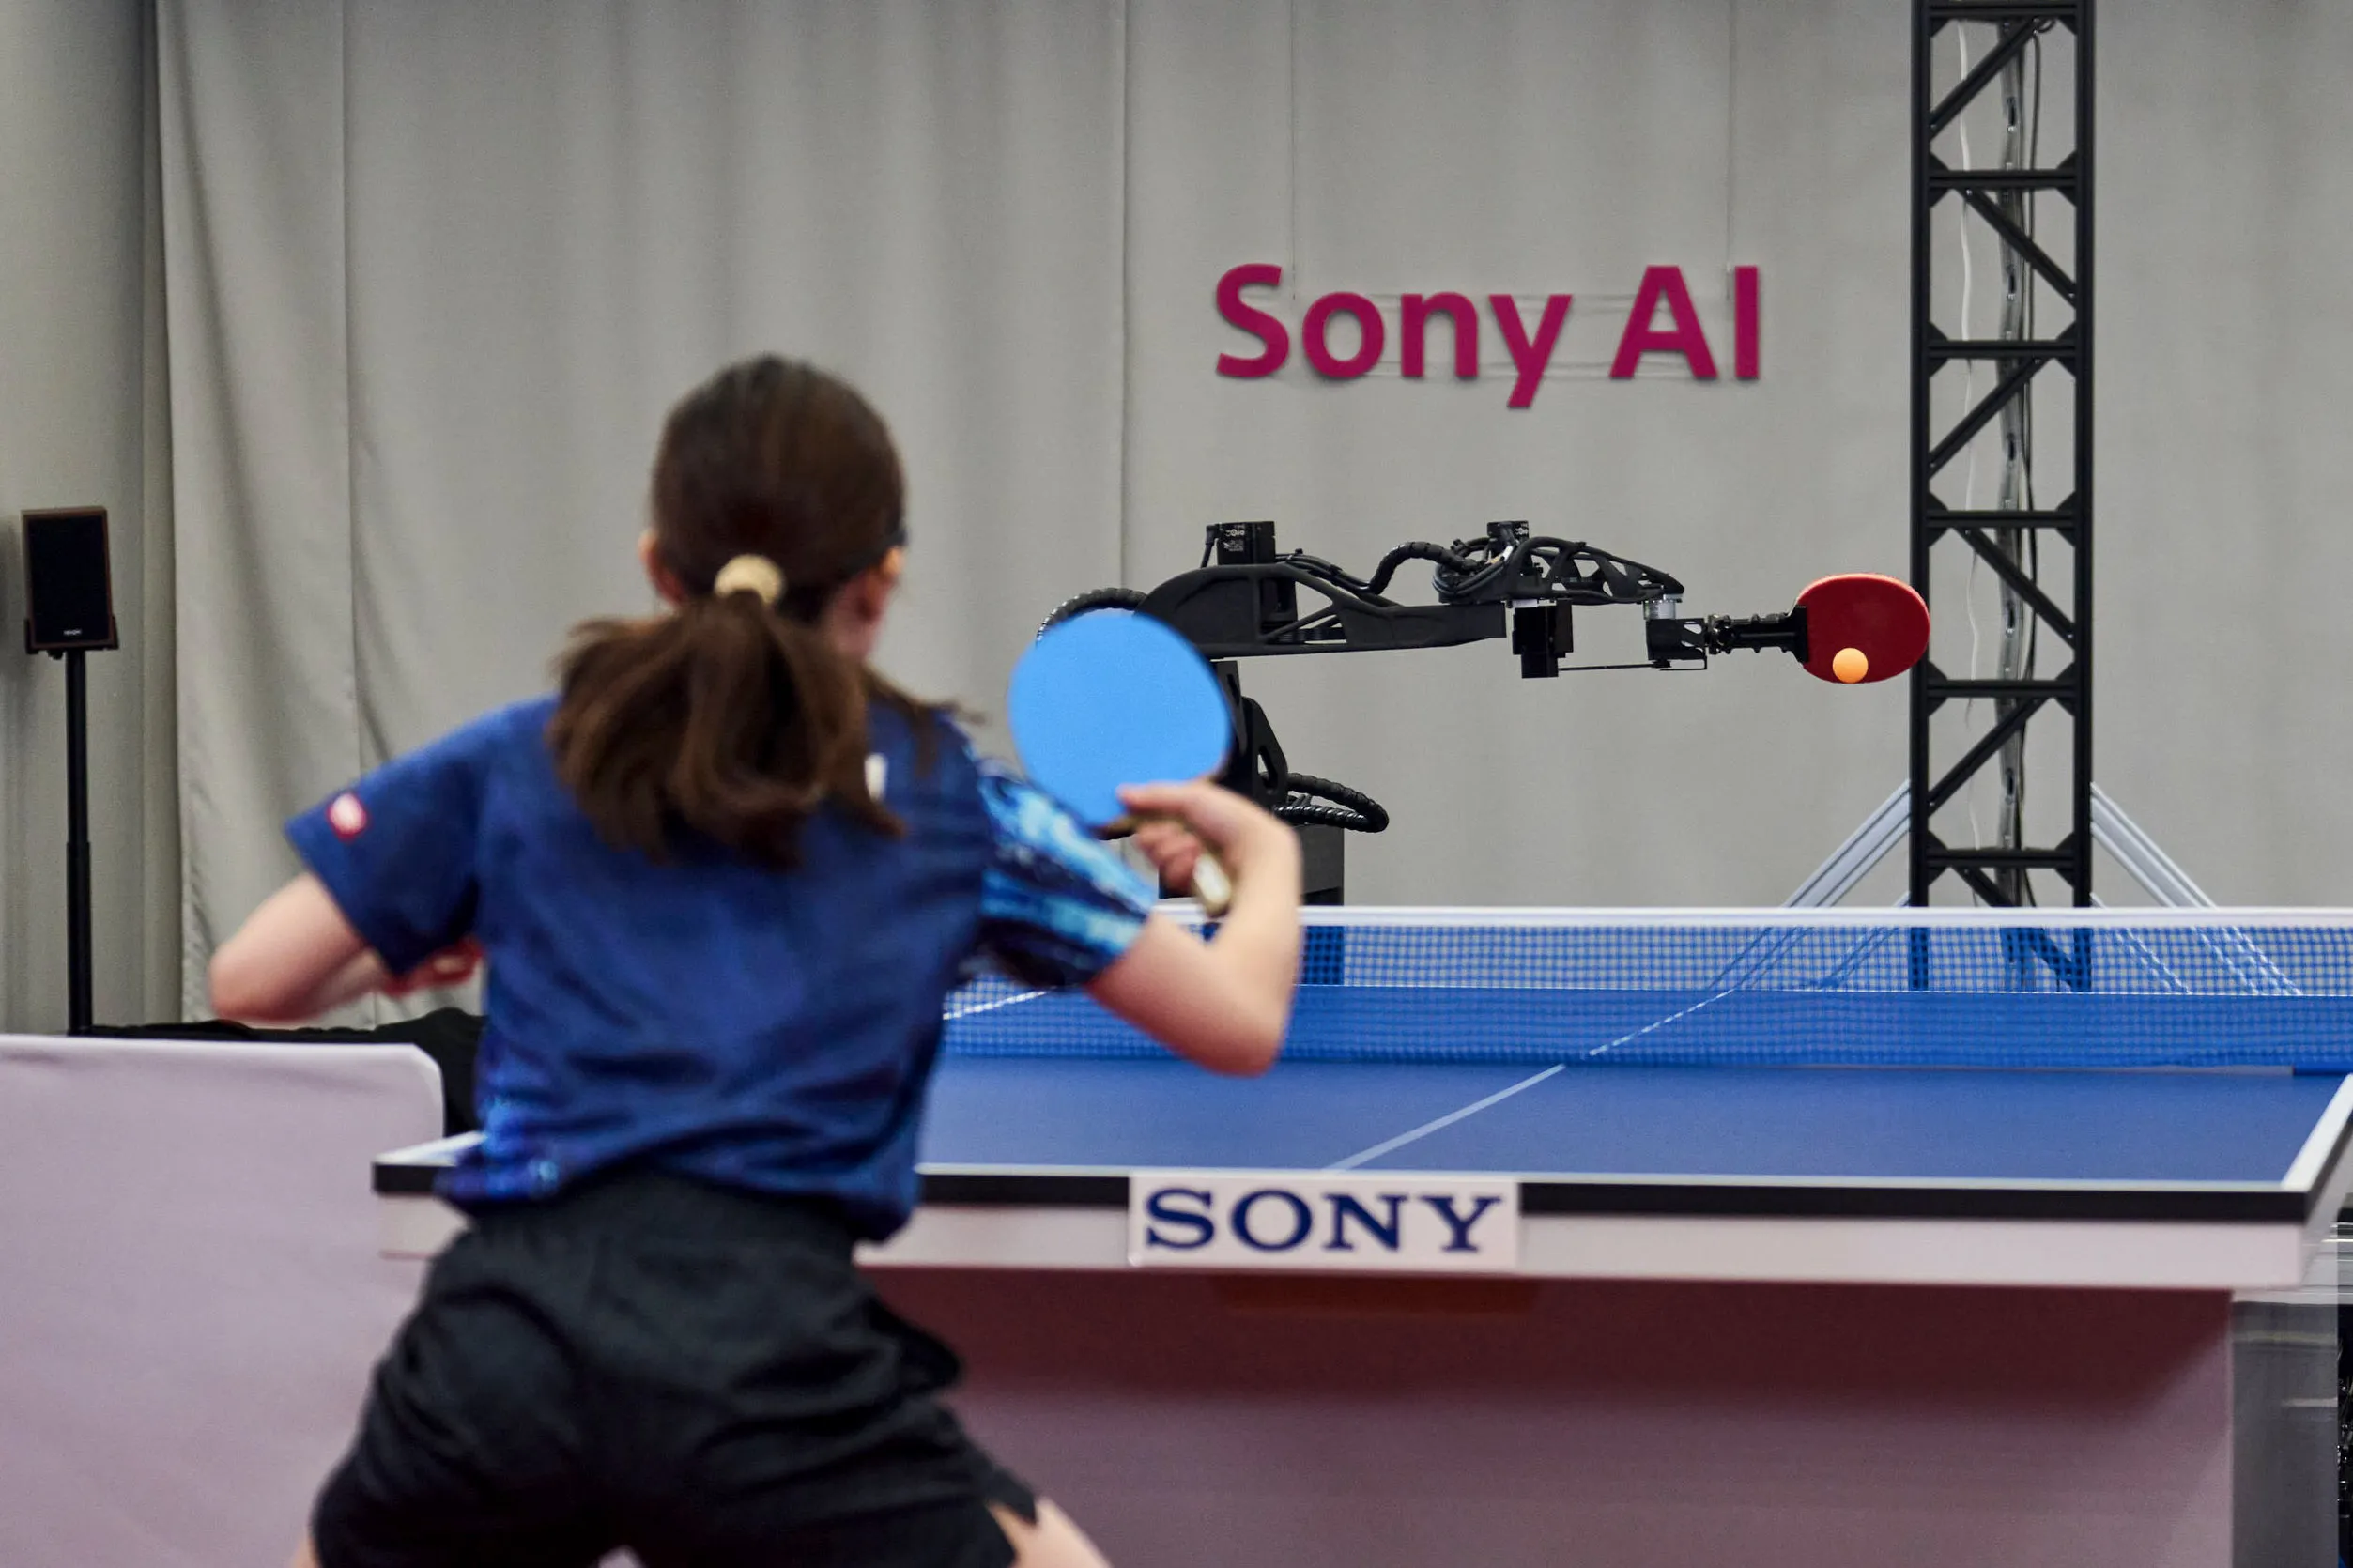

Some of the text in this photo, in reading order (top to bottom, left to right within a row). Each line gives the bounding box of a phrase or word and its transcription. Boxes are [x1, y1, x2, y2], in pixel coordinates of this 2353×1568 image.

[1215, 263, 1761, 408] Sony AI
[1145, 1188, 1502, 1252] SONY
